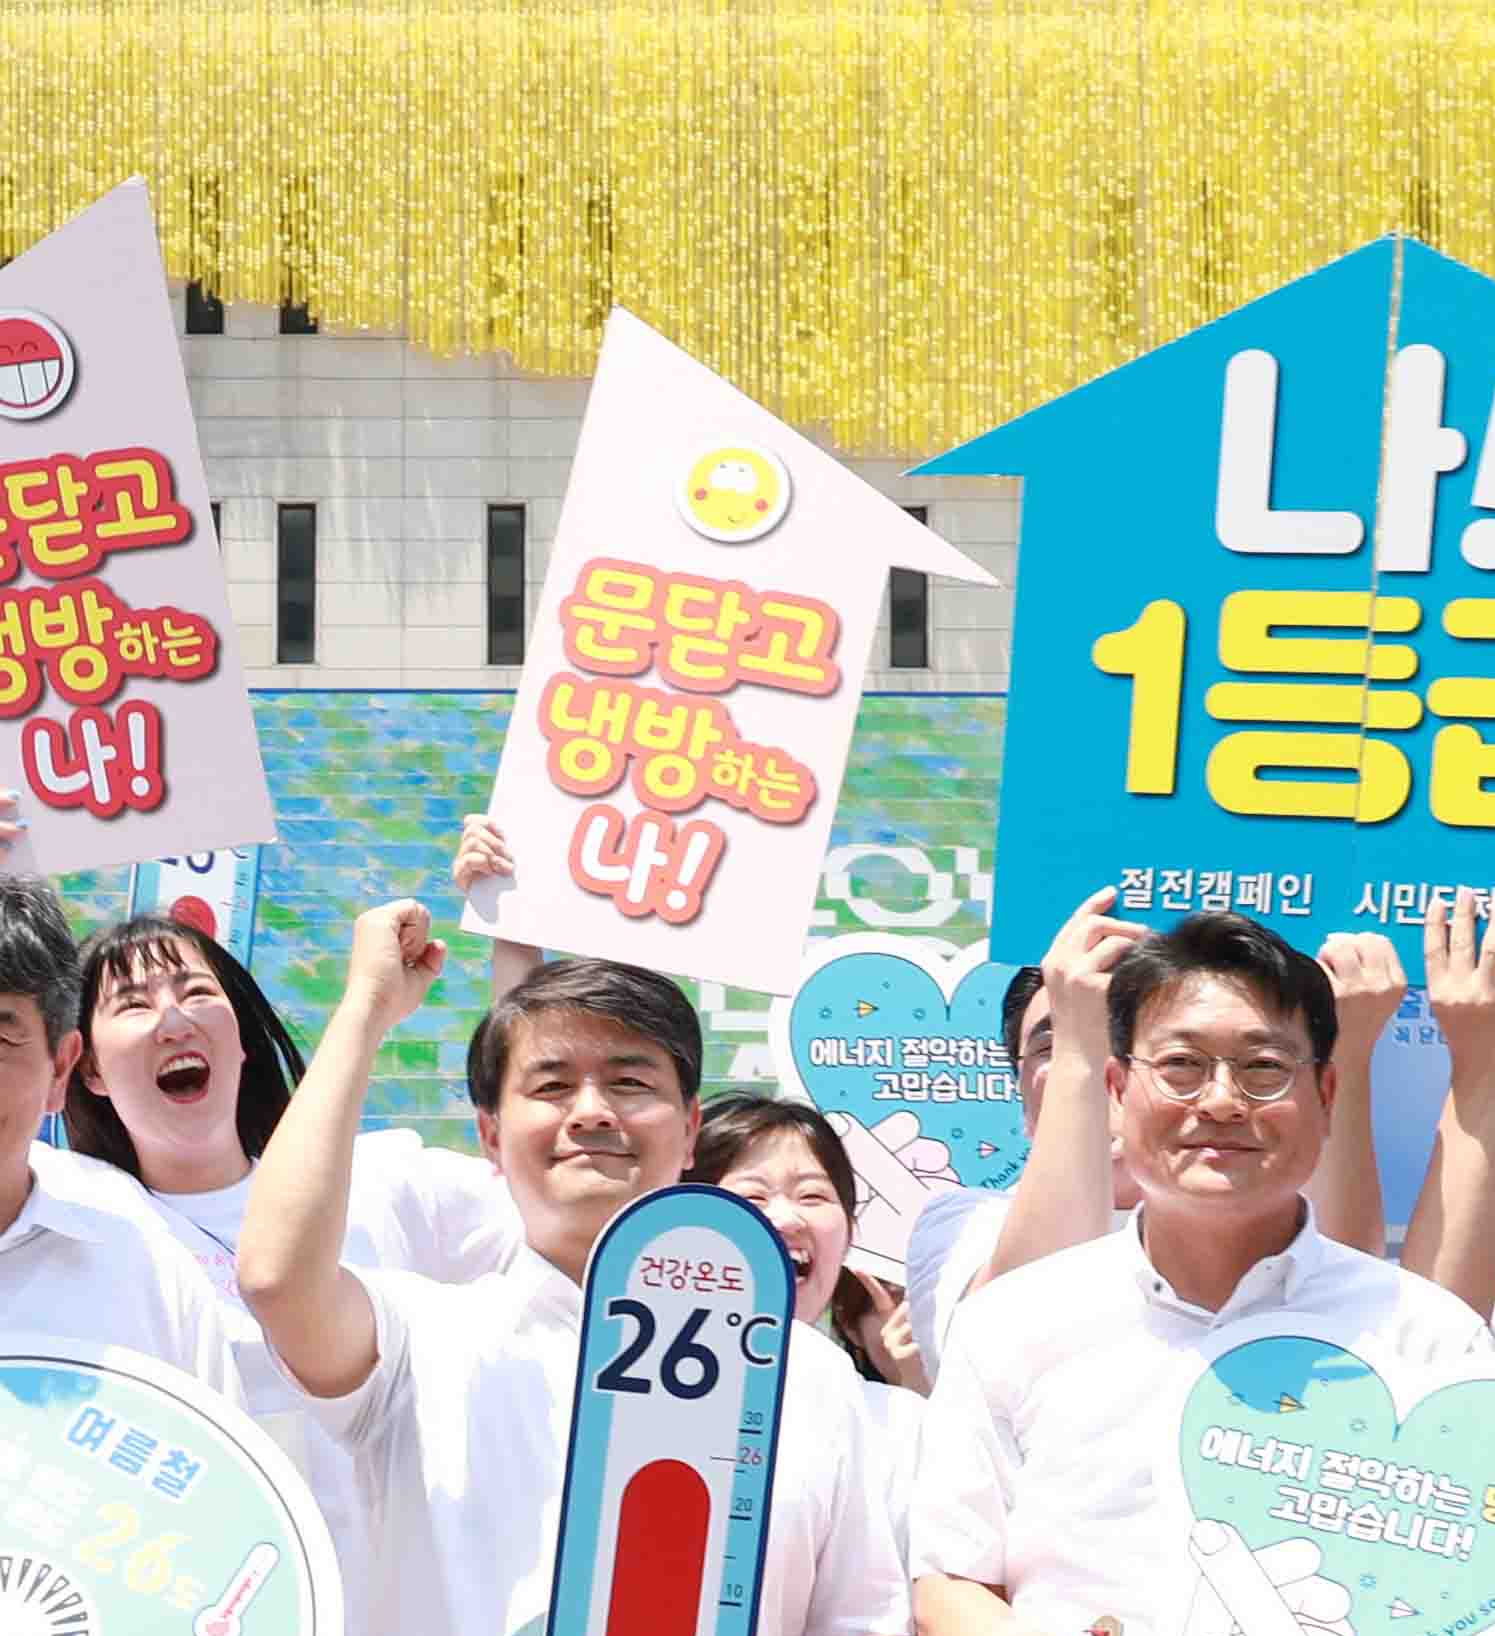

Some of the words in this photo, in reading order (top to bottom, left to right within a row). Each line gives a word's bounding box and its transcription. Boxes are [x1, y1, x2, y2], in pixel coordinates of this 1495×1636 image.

[570, 567, 826, 683] 문닫고
[33, 712, 151, 803] 나!
[550, 684, 802, 809] 냉방하는
[580, 816, 708, 911] 나!
[1119, 867, 1312, 916] 절전캠페인
[810, 1038, 893, 1067] 에너지
[901, 1037, 1009, 1068] 절약하는
[641, 1256, 744, 1292] 건강온도
[66, 1405, 201, 1499] 여름철
[739, 1448, 762, 1466] 26
[1201, 1426, 1313, 1481] 에너지
[1320, 1449, 1471, 1516] 절약하는
[1268, 1486, 1475, 1562] 고맙습니다!
[726, 1584, 743, 1598] 10
